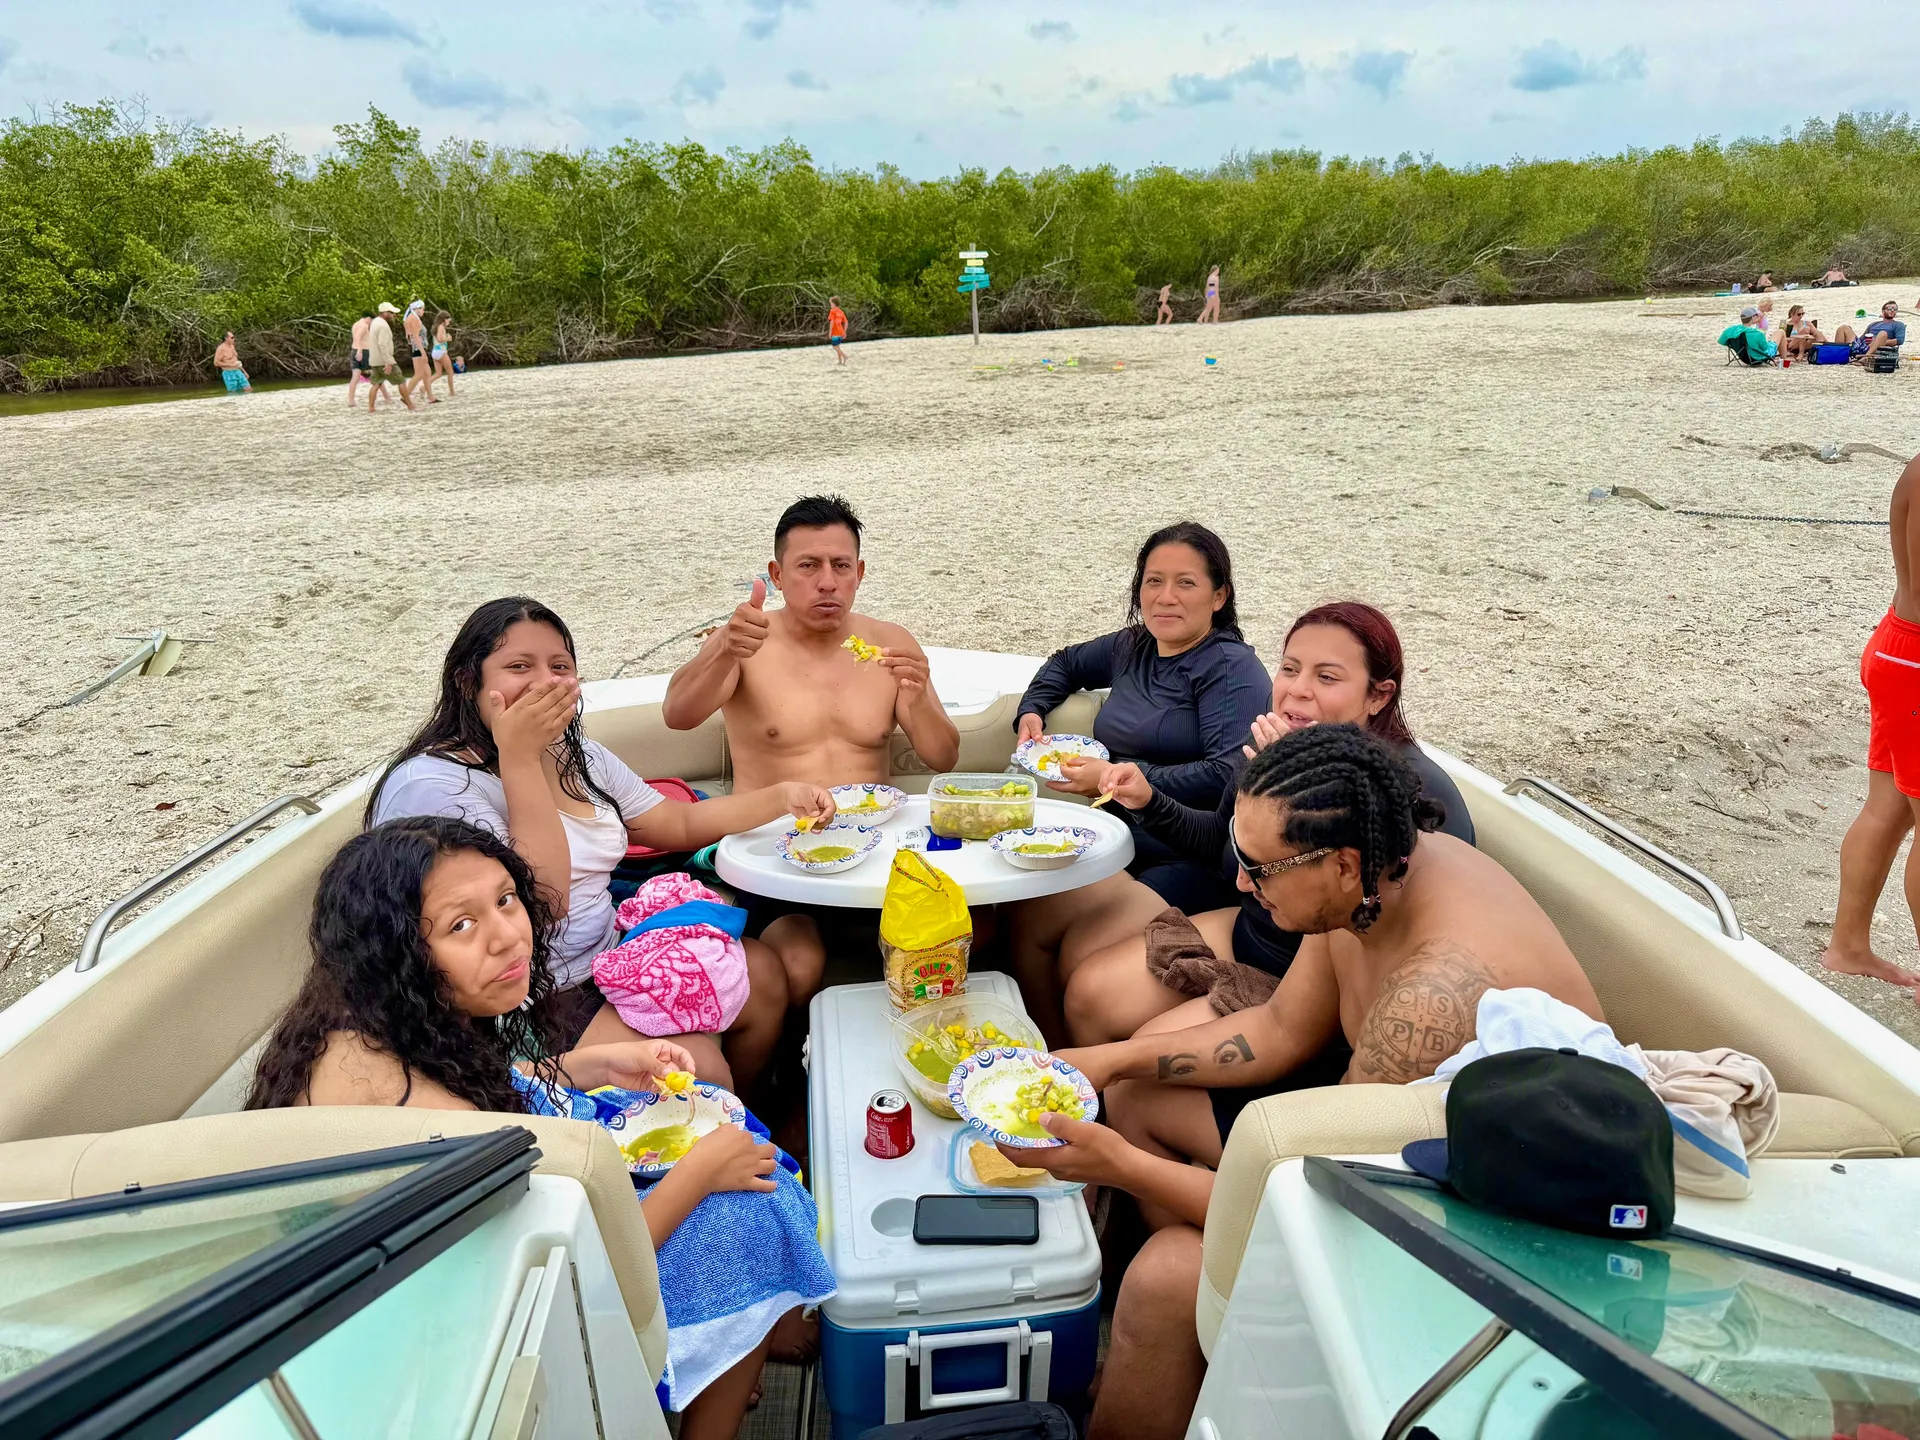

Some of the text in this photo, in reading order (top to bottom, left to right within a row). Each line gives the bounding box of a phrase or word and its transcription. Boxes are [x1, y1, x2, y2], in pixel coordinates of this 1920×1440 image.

[1397, 989, 1411, 1005] C
[1437, 996, 1448, 1014] S
[1391, 1023, 1406, 1039] P
[1431, 1033, 1445, 1051] B
